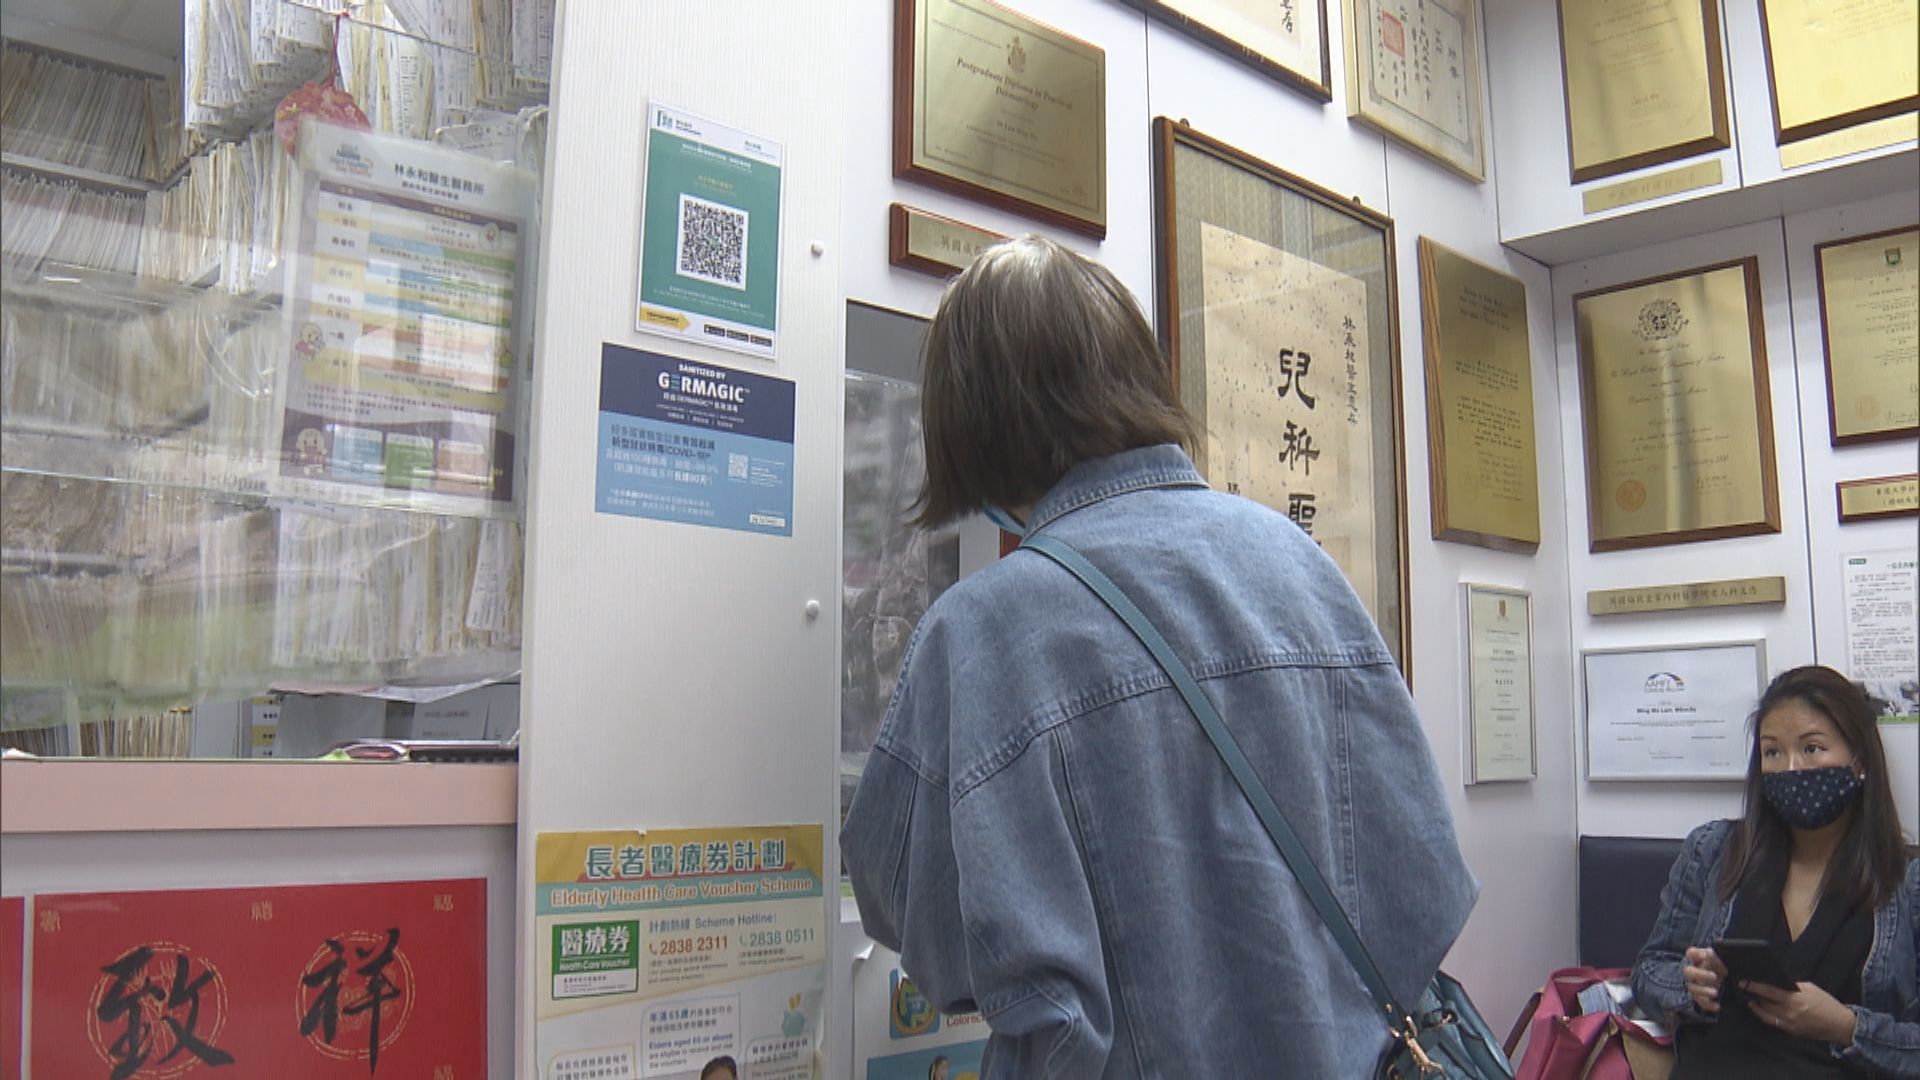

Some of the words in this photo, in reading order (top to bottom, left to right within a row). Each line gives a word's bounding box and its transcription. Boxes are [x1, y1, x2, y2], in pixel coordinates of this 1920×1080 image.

[957, 56, 1002, 82] Postgraduate
[1004, 75, 1033, 95] Diploma
[678, 363, 715, 378] SANITIZED
[716, 369, 727, 380] BY
[1276, 347, 1322, 548] 兒科聖
[586, 839, 785, 878] 長者醫療券計劃
[551, 889, 608, 908] Elderly
[611, 886, 661, 905] Health
[664, 882, 697, 900] Care
[699, 879, 757, 897] Voucher
[760, 877, 812, 893] Scheme
[694, 915, 736, 930] Scheme
[737, 913, 777, 927] Hotline:
[561, 925, 631, 957] 醫療券
[659, 937, 694, 956] 2838
[696, 935, 729, 952] 2311
[749, 930, 782, 947] 2838
[785, 928, 815, 944] 0511
[583, 959, 600, 970] Care
[673, 1037, 691, 1049] aged
